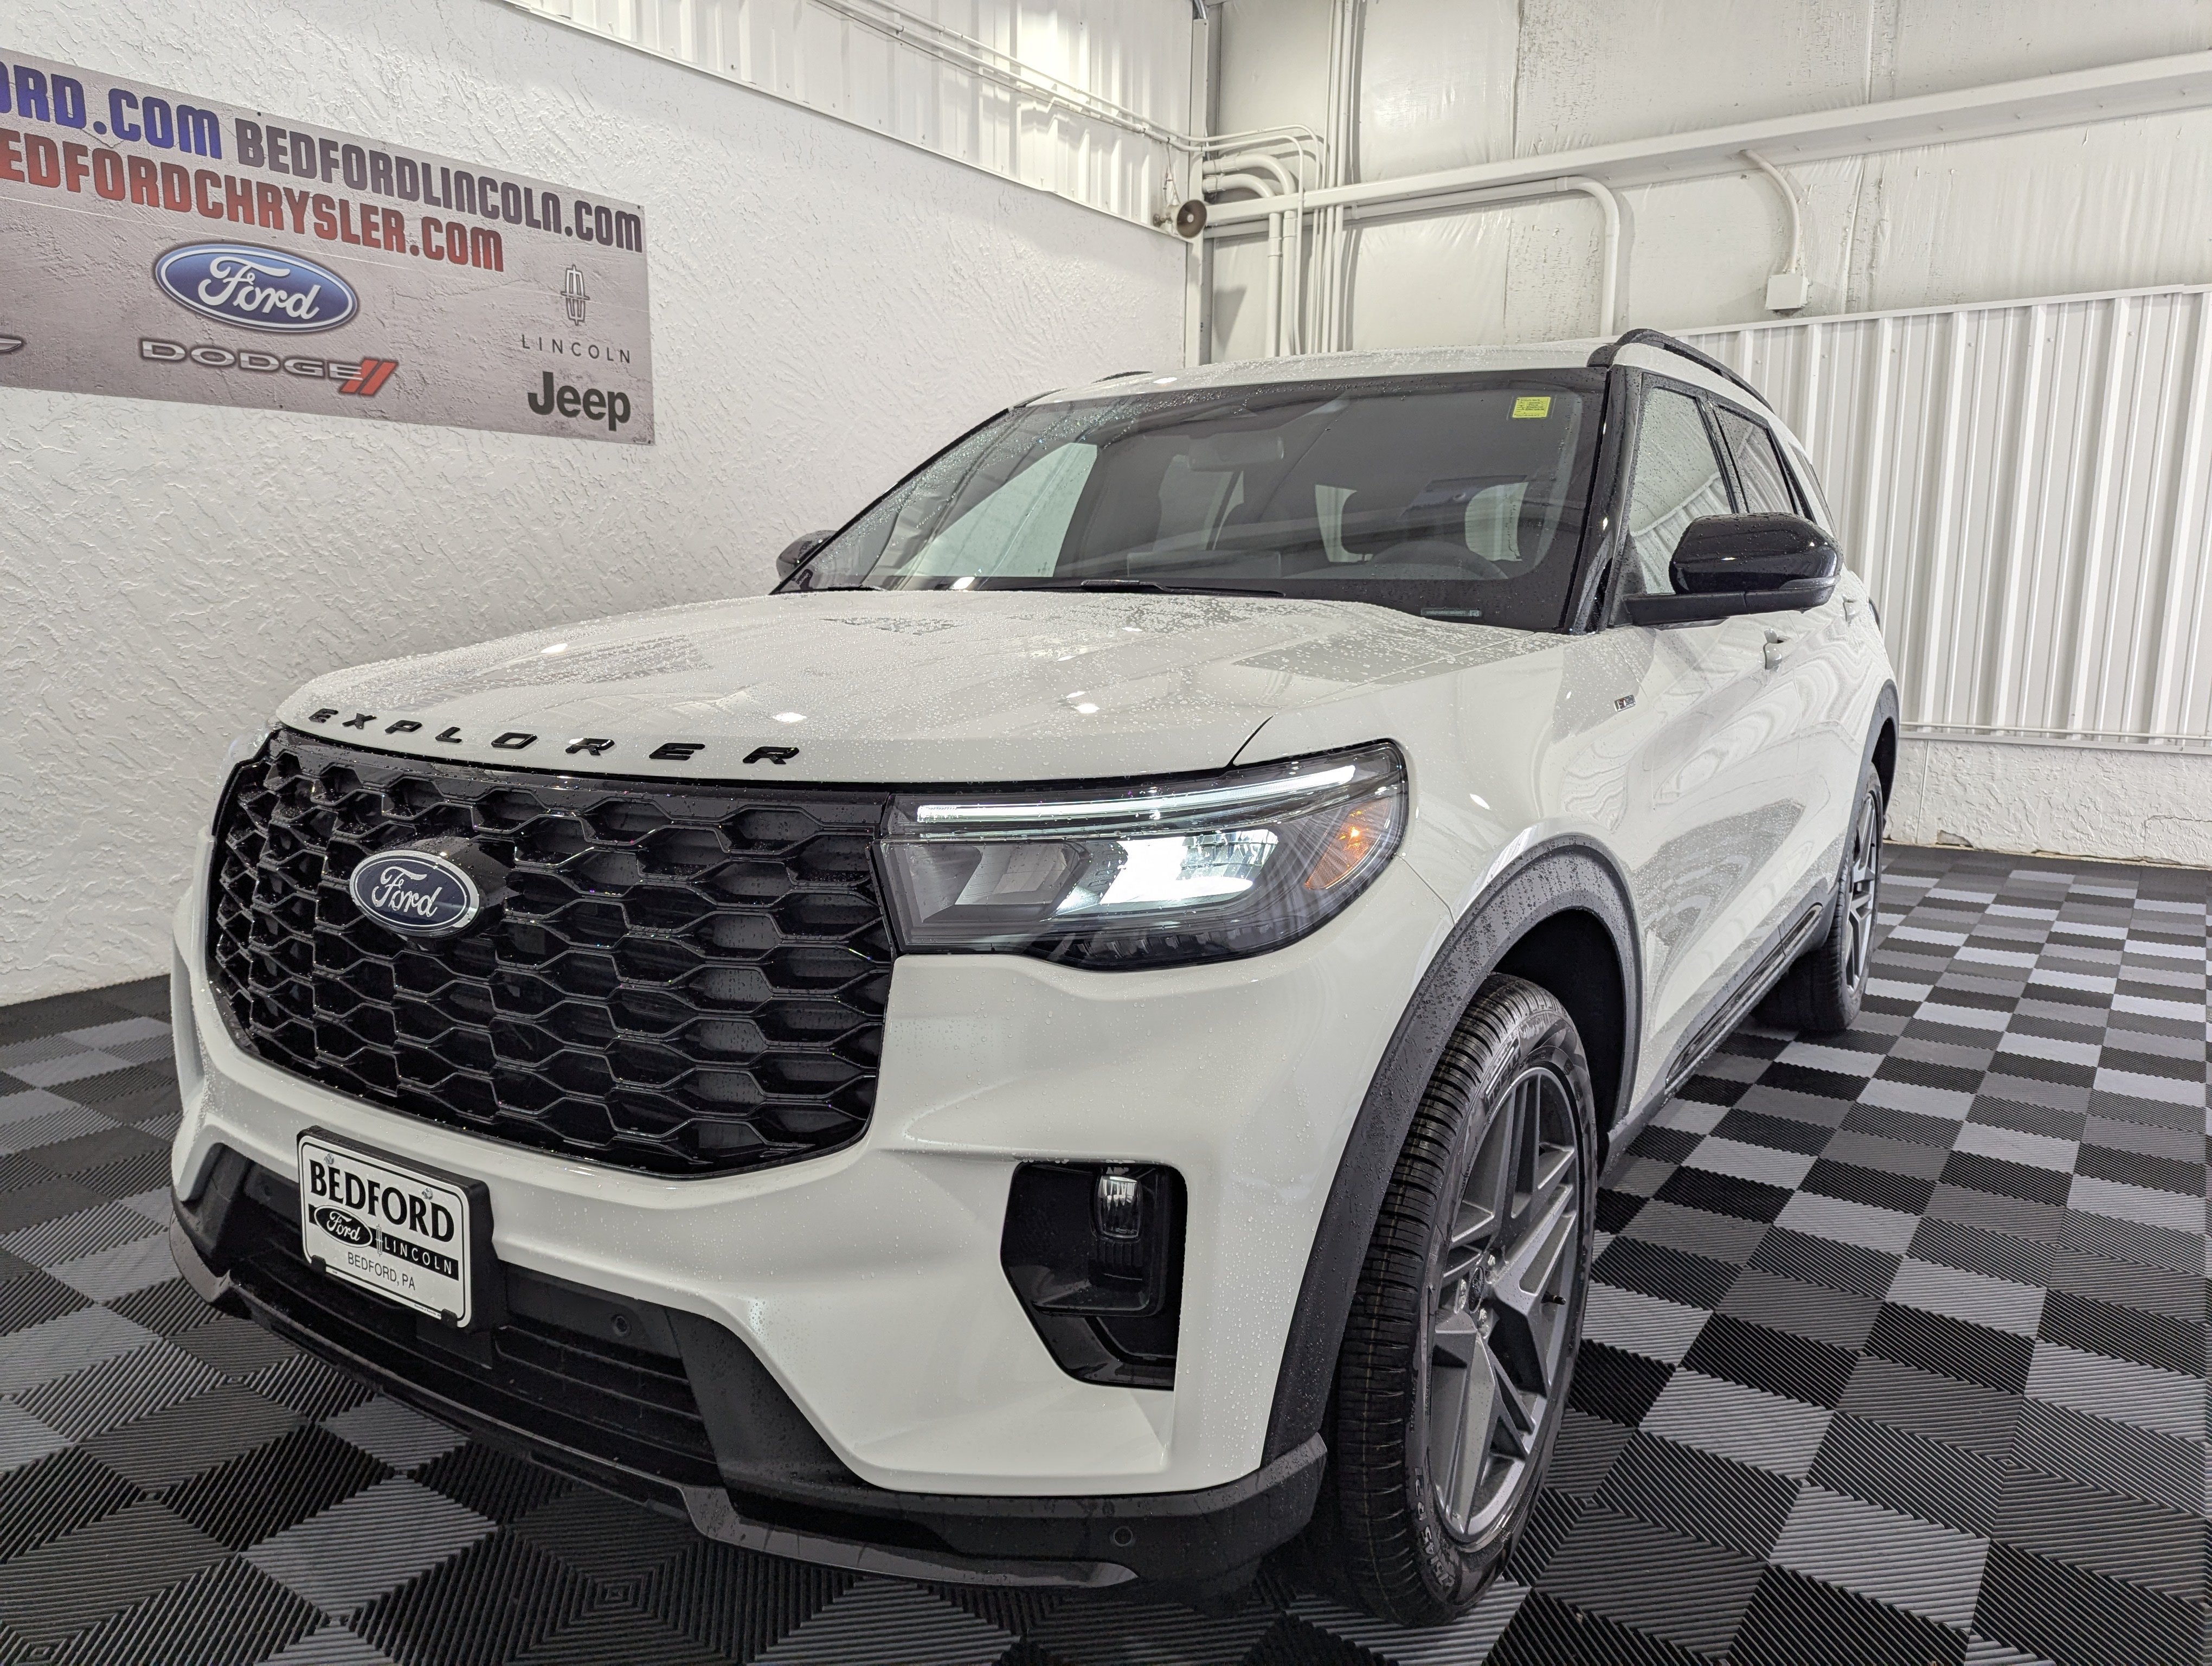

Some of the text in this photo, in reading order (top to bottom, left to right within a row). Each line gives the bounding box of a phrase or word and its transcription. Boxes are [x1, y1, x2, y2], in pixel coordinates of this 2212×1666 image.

[235, 118, 642, 253] BEDFORDLINCOLN.COM
[198, 255, 319, 319] Ford
[142, 341, 363, 380] DODGE
[522, 335, 631, 363] LINCOLN
[528, 371, 631, 432] Jeep
[308, 708, 800, 765] EXPLORER
[372, 865, 440, 918] Ford
[309, 1159, 454, 1242] BEDFORD
[326, 1210, 360, 1242] Ford
[348, 1252, 416, 1290] BEDFORD, PA
[384, 1238, 452, 1275] LINCOLN
